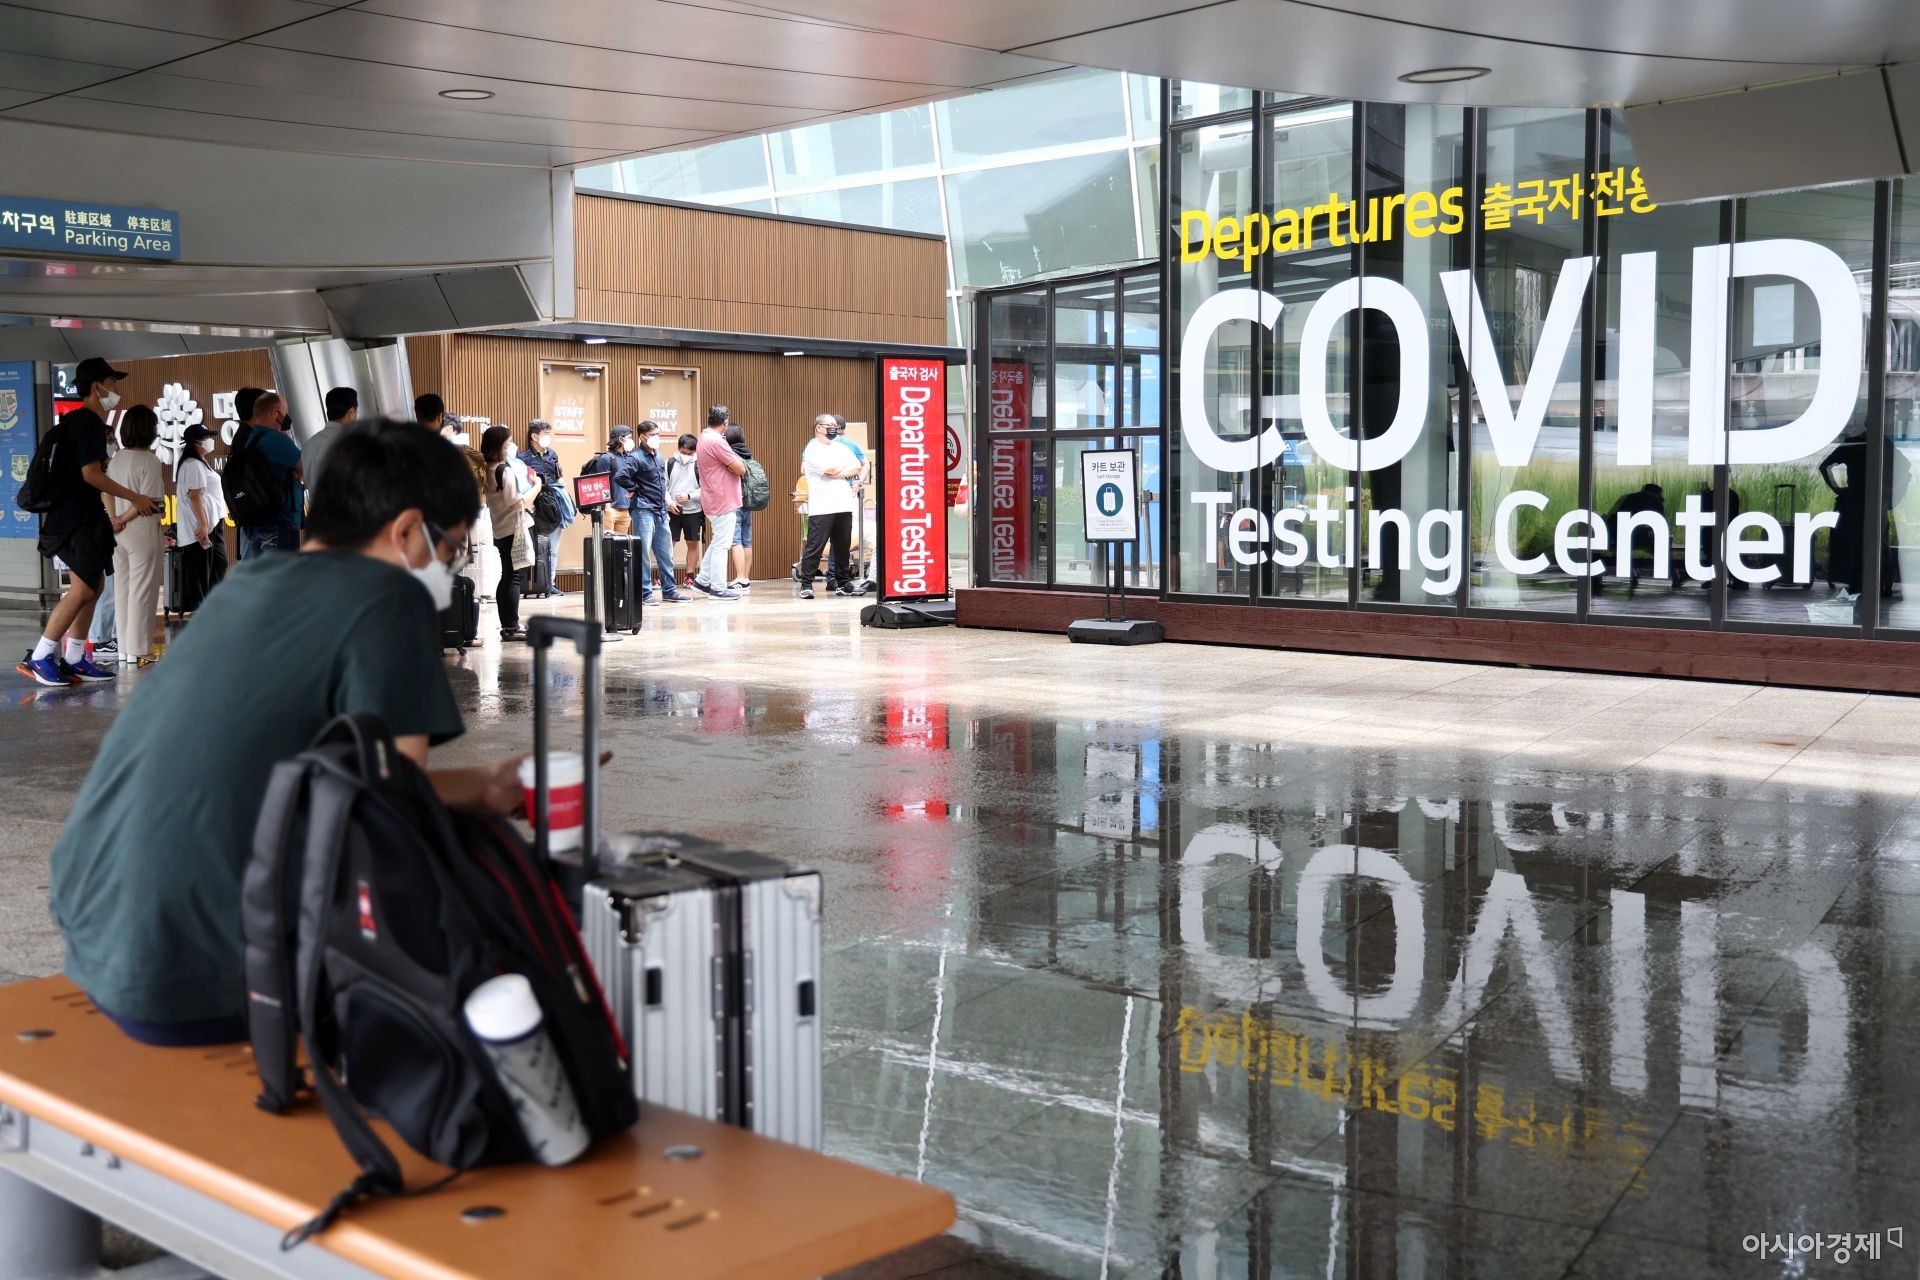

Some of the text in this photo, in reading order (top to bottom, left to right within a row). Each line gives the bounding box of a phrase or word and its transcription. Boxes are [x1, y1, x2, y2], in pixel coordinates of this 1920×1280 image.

[0, 210, 56, 236] 차구역
[127, 215, 173, 232] 停车区域
[1180, 185, 1464, 272] Departures
[1480, 173, 1586, 231] 출국자
[65, 229, 171, 252] Parking Area
[1180, 239, 1864, 472] COVID
[889, 366, 939, 381] 출국자 검사
[553, 406, 585, 418] STAFF
[649, 408, 678, 419] STAFF
[553, 418, 585, 431] ONLY
[653, 420, 678, 433] NLY
[1091, 461, 1126, 473] 카트 보관
[892, 386, 935, 594] Departures Testing
[1190, 489, 1840, 595] Testing Center
